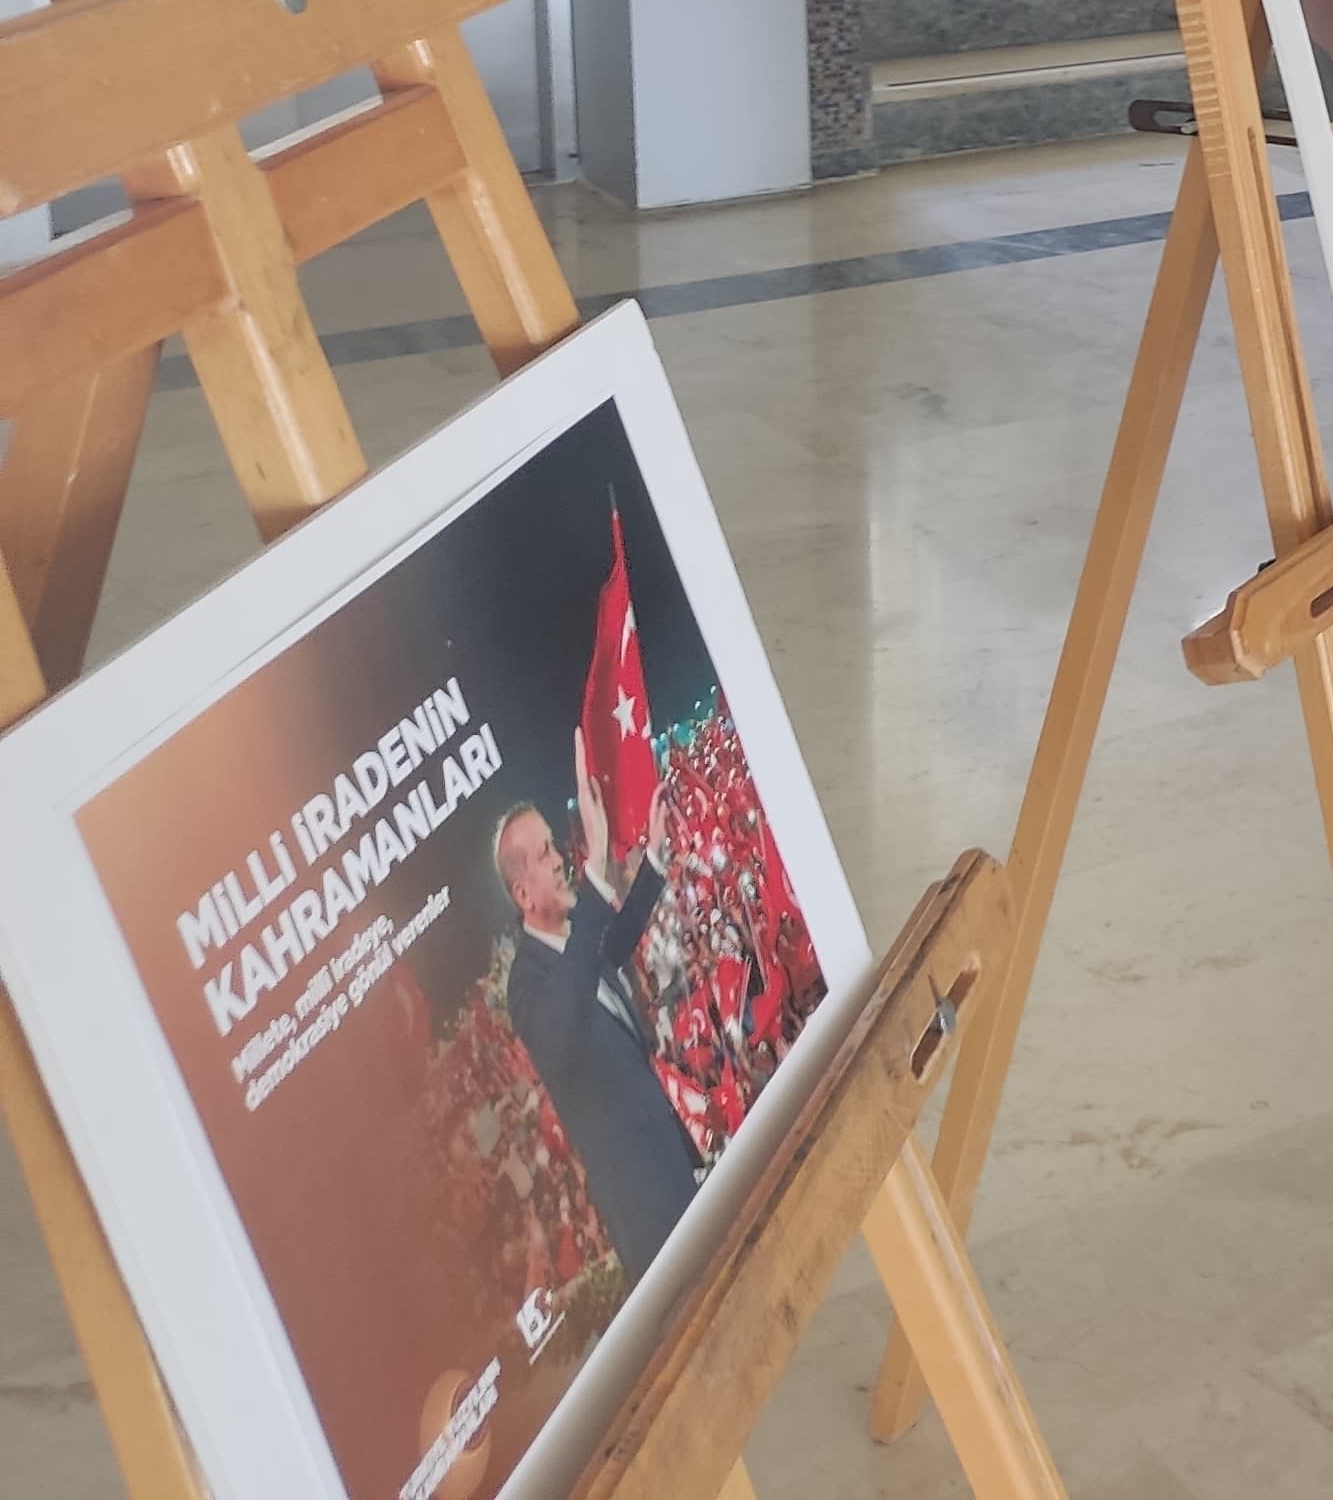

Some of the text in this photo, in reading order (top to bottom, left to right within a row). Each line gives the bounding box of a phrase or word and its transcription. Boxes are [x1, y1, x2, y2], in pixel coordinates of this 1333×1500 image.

[176, 676, 471, 970] MİLLİ İRADENİN
[203, 722, 503, 1037] KAHRAMANLARI
